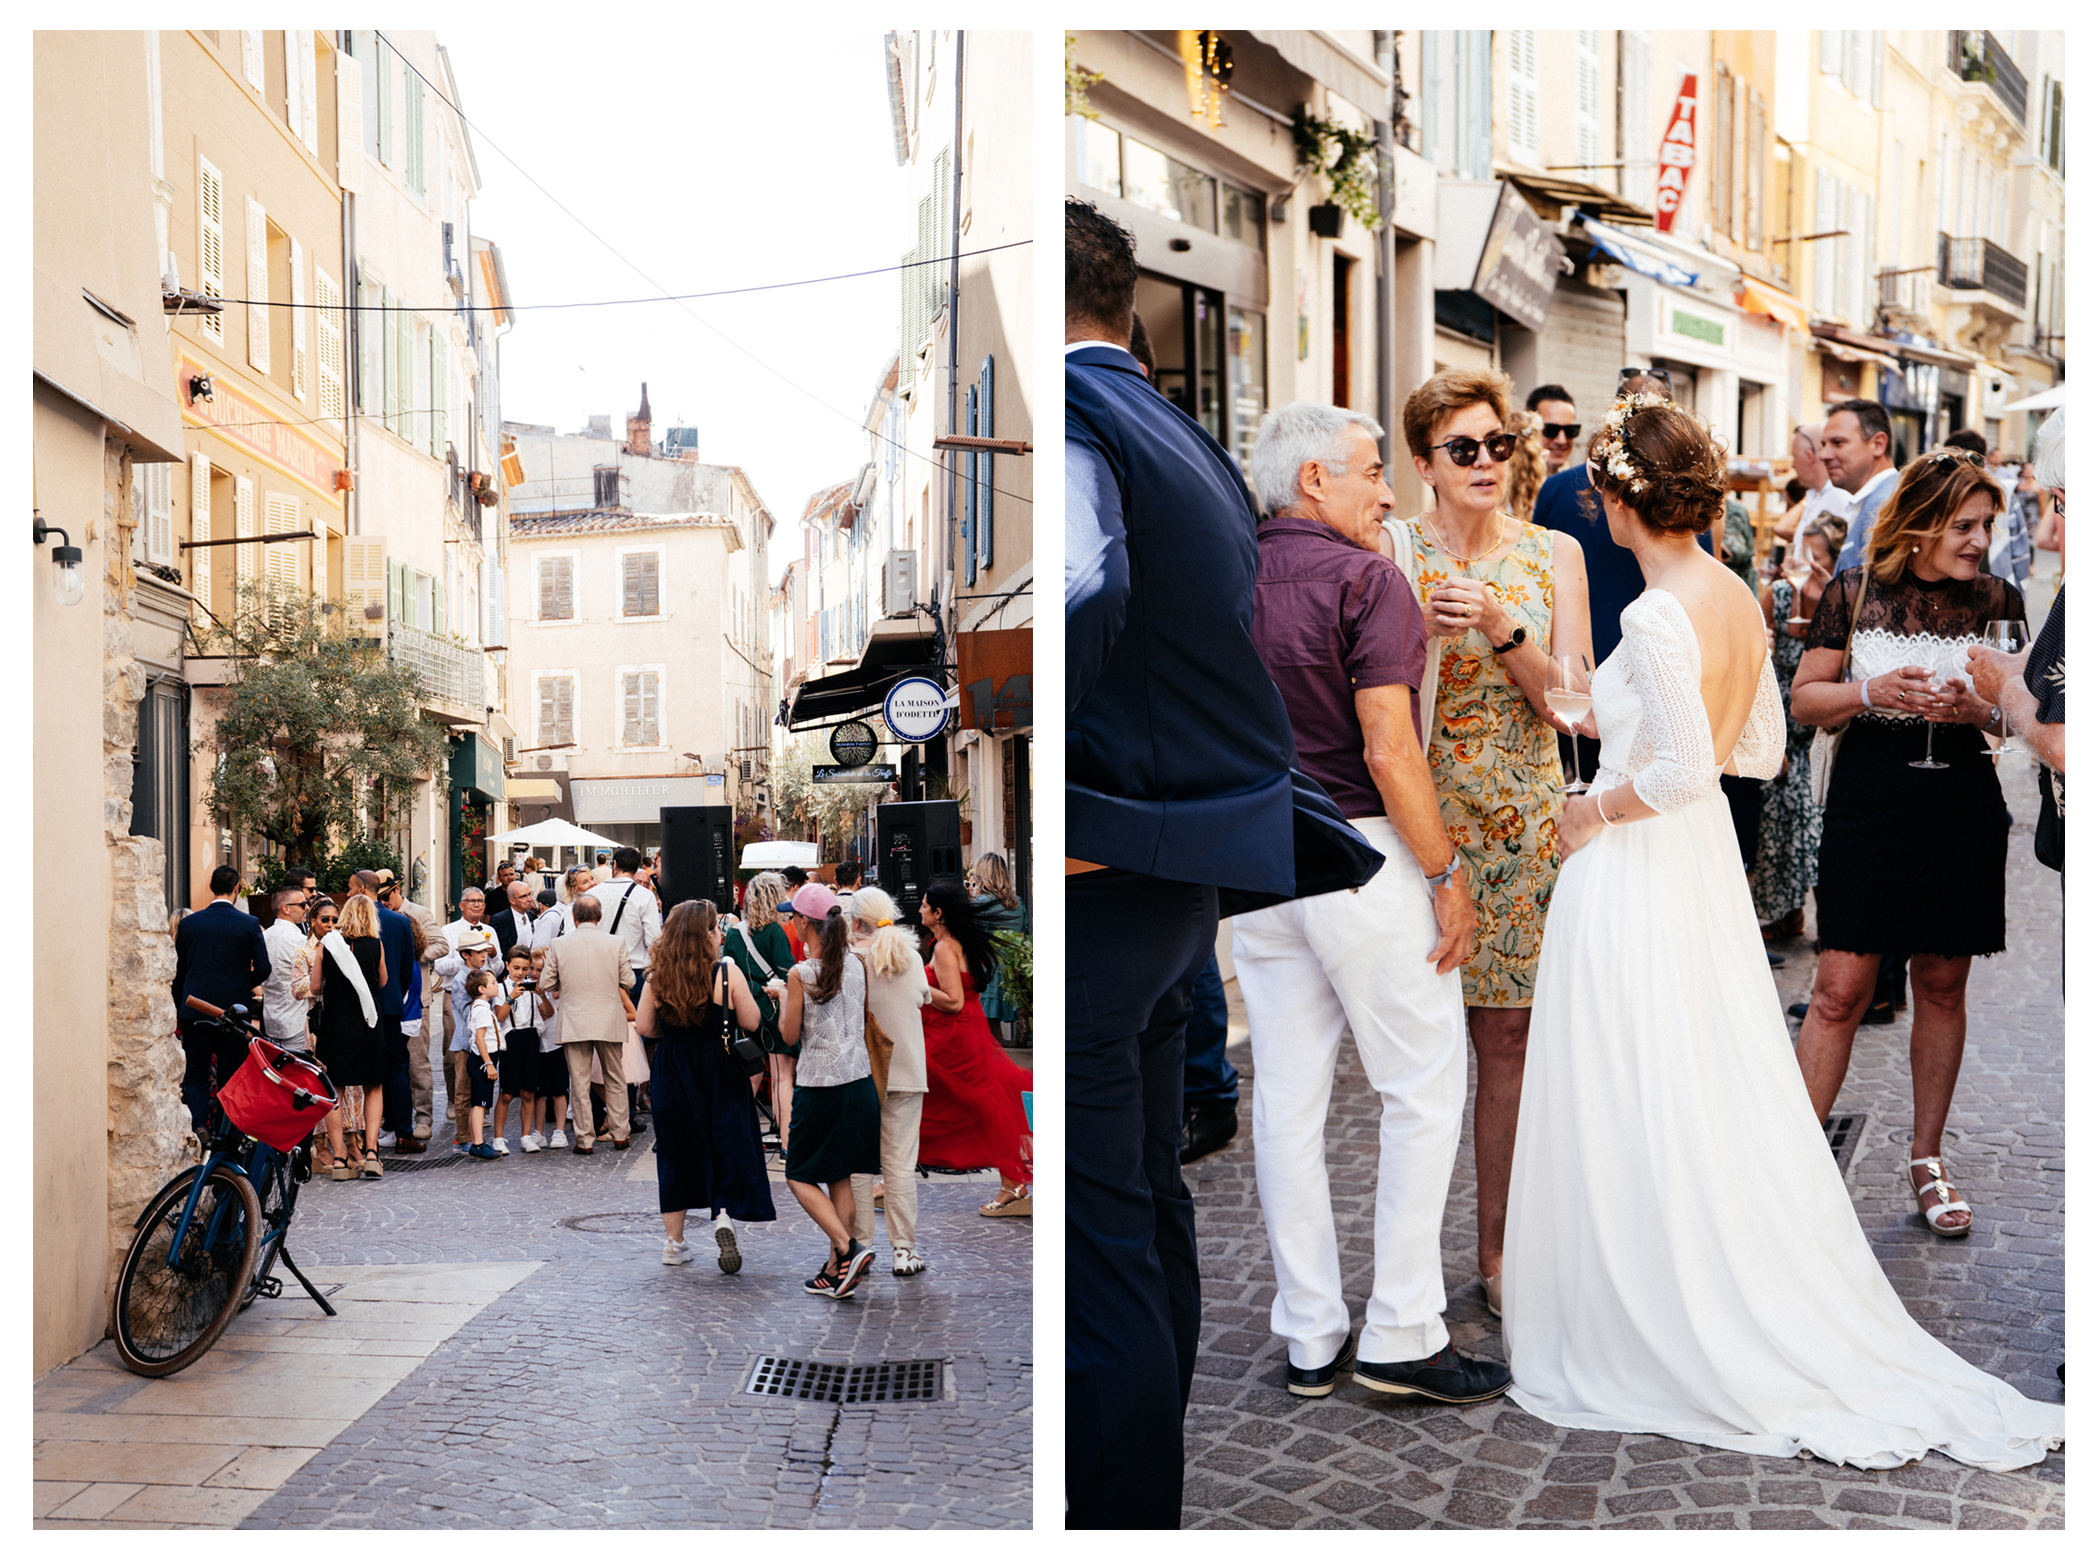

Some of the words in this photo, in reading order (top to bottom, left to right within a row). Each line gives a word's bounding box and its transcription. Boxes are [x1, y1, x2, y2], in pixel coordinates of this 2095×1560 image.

[1658, 96, 1697, 213] TABAC
[275, 423, 316, 479] MARTIN
[580, 785, 670, 797] IMMOBILIER
